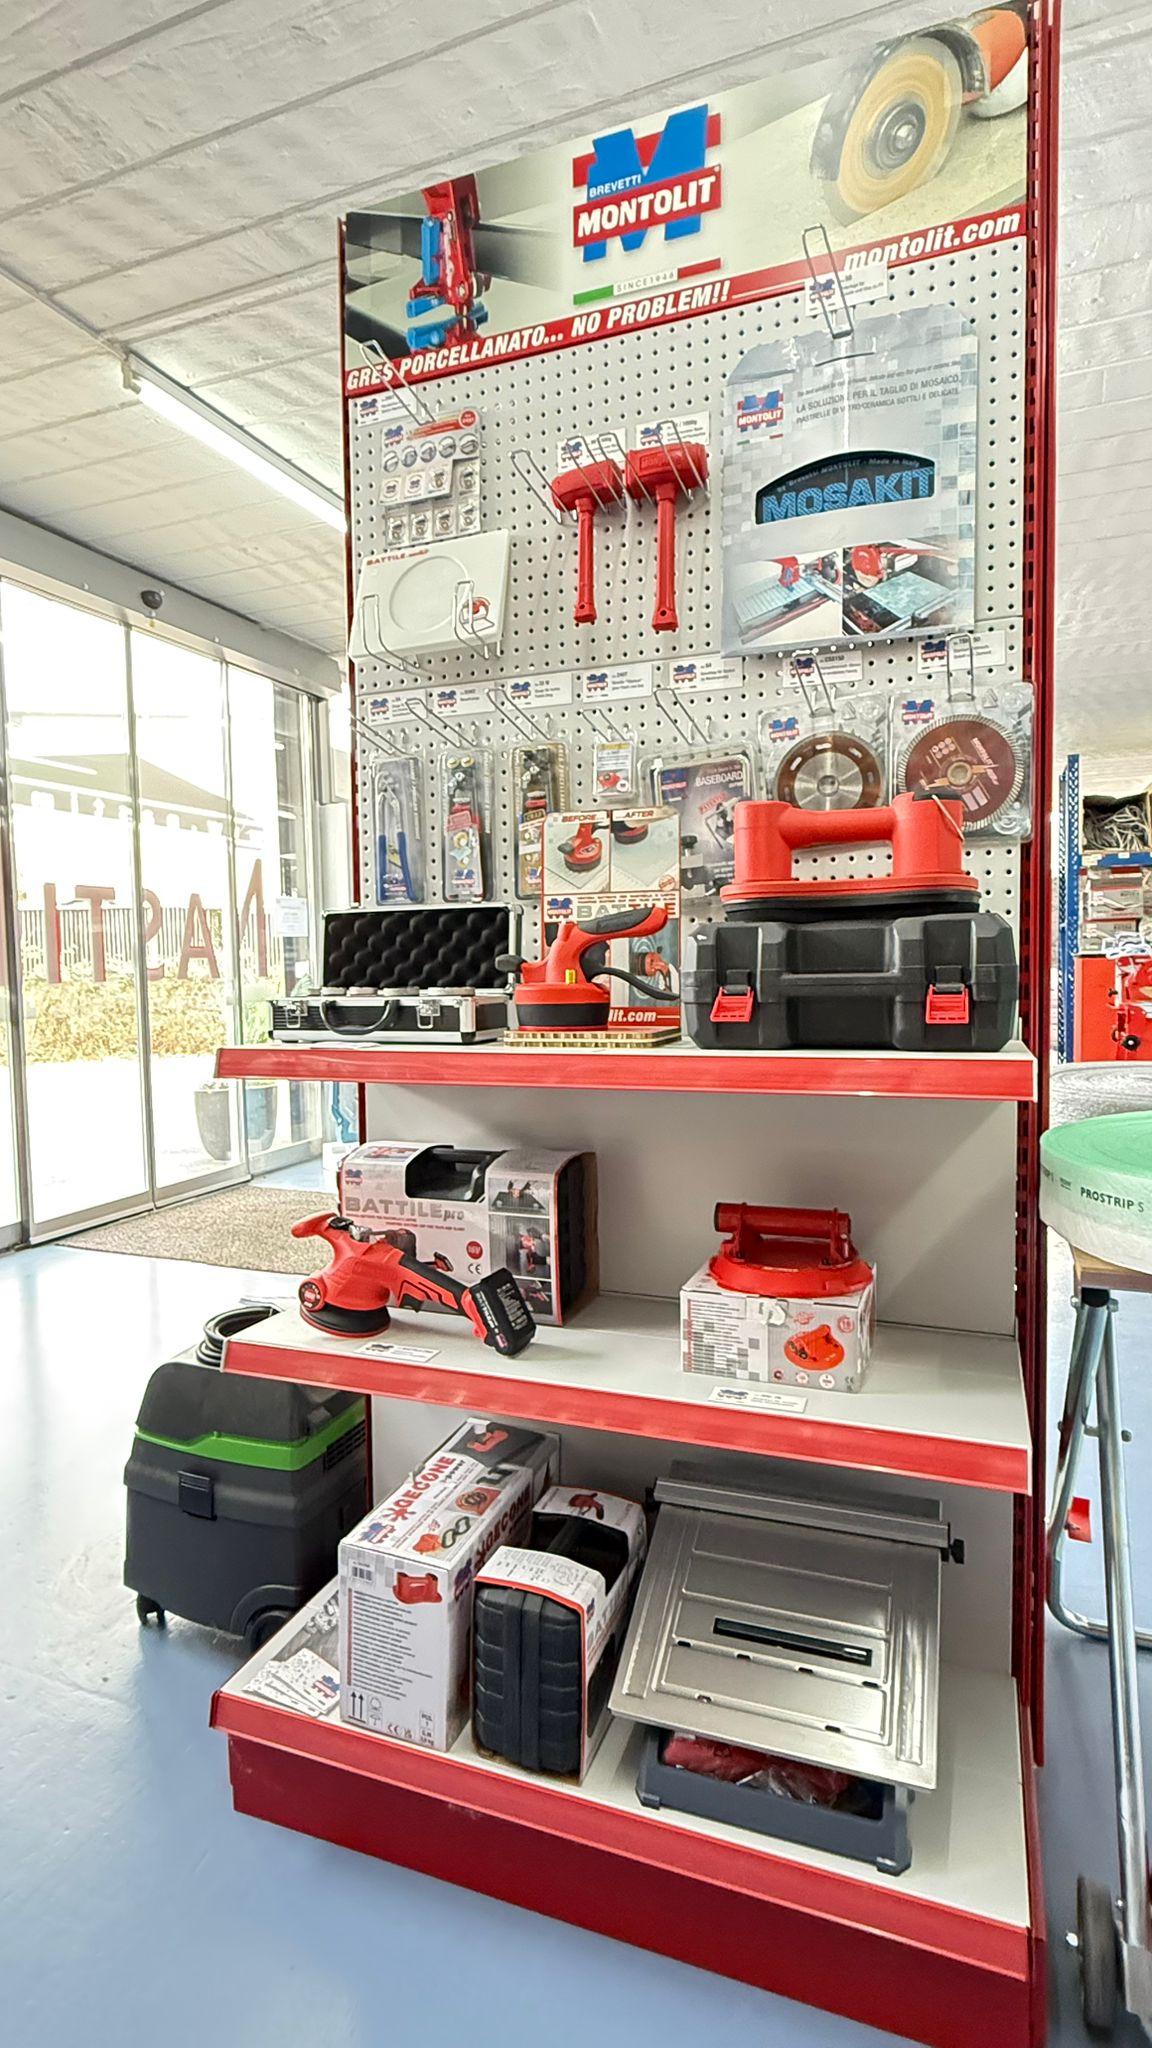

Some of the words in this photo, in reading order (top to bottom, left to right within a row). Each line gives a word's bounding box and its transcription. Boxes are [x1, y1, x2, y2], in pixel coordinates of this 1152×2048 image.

[589, 173, 642, 199] BREVETTI
[577, 175, 716, 238] MONTOLIT
[843, 212, 1020, 271] montolit.com
[347, 364, 394, 390] GRES
[399, 325, 564, 377] PORCELLANATO...
[571, 313, 602, 338] NO
[607, 280, 731, 329] PROBLEM!!
[738, 409, 782, 425] MONTOLIT
[763, 466, 934, 523] MOSAKIT
[577, 903, 676, 919] BATE
[345, 1196, 443, 1219] BATTILE
[443, 1209, 465, 1222] pro
[1080, 1186, 1135, 1210] PROSTRIP
[1137, 1201, 1145, 1213] S
